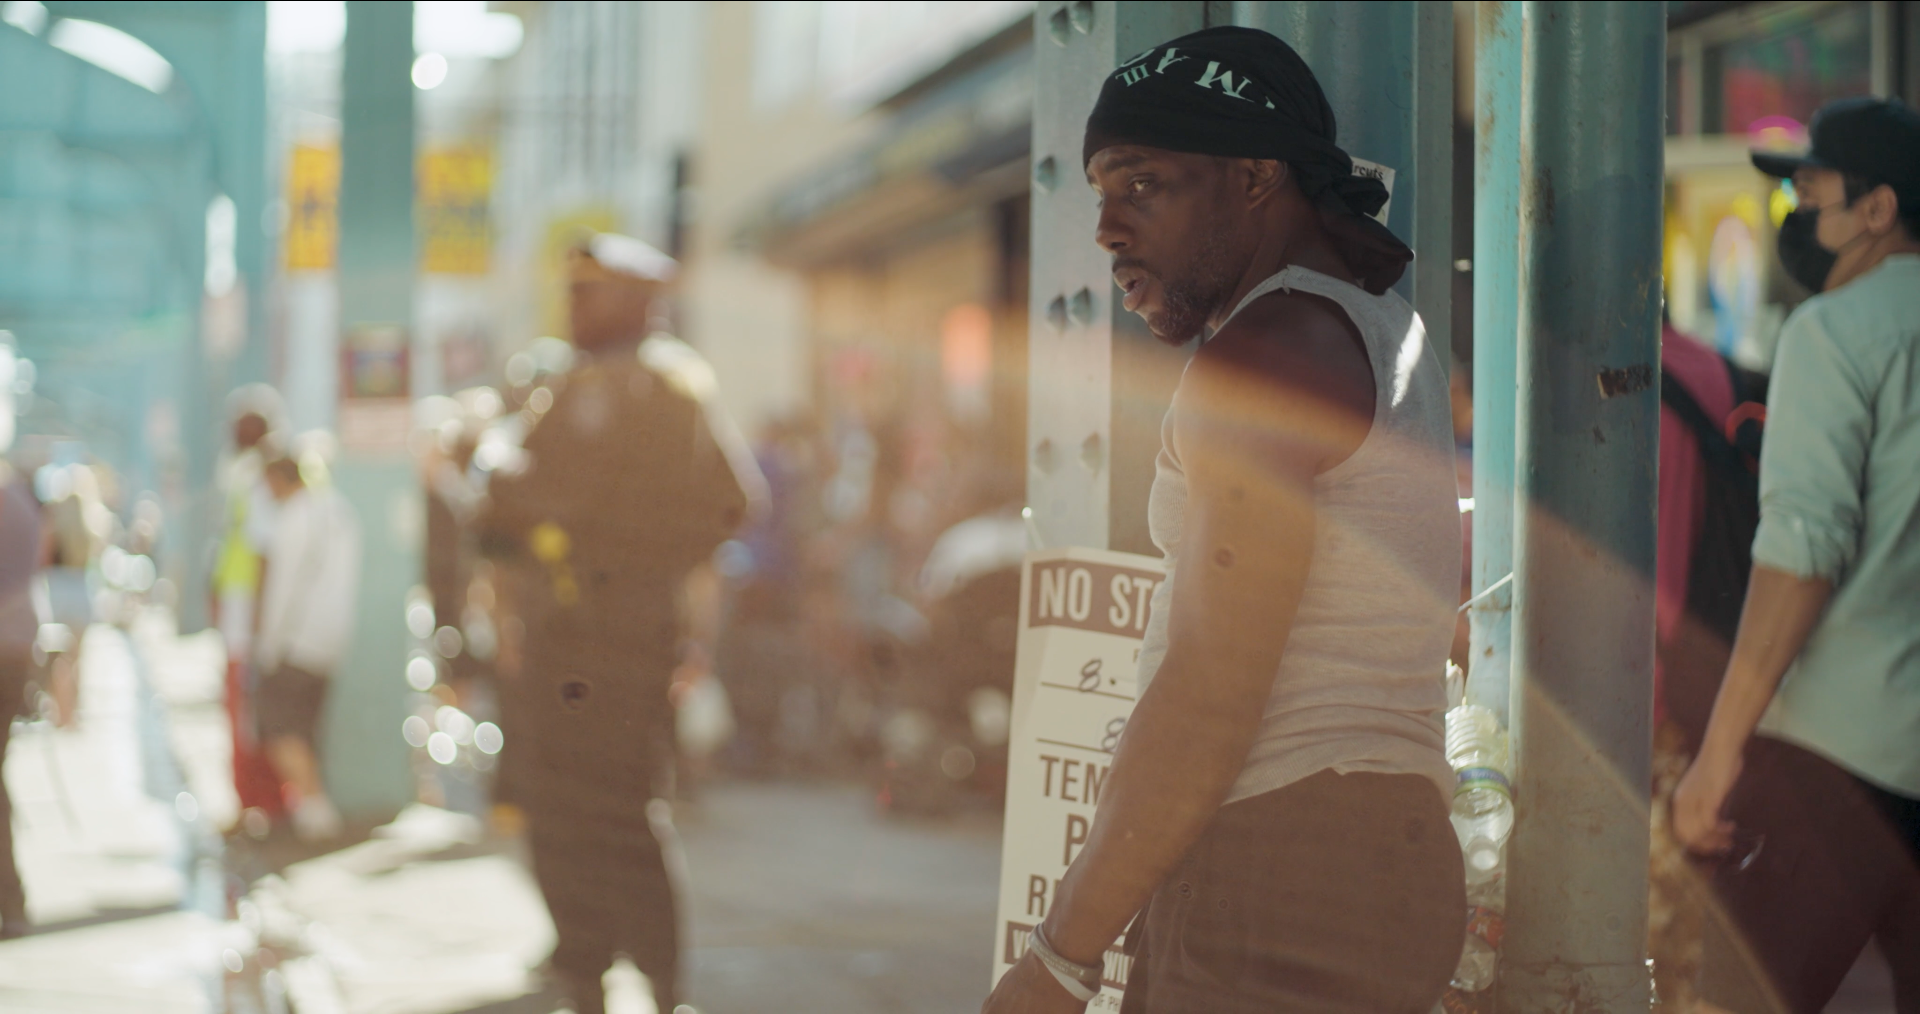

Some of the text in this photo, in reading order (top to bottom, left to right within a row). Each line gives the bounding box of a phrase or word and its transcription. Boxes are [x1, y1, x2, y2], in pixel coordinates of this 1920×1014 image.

[1353, 161, 1384, 180] rcuts
[1038, 567, 1164, 631] NO ST
[1027, 873, 1062, 918] R
